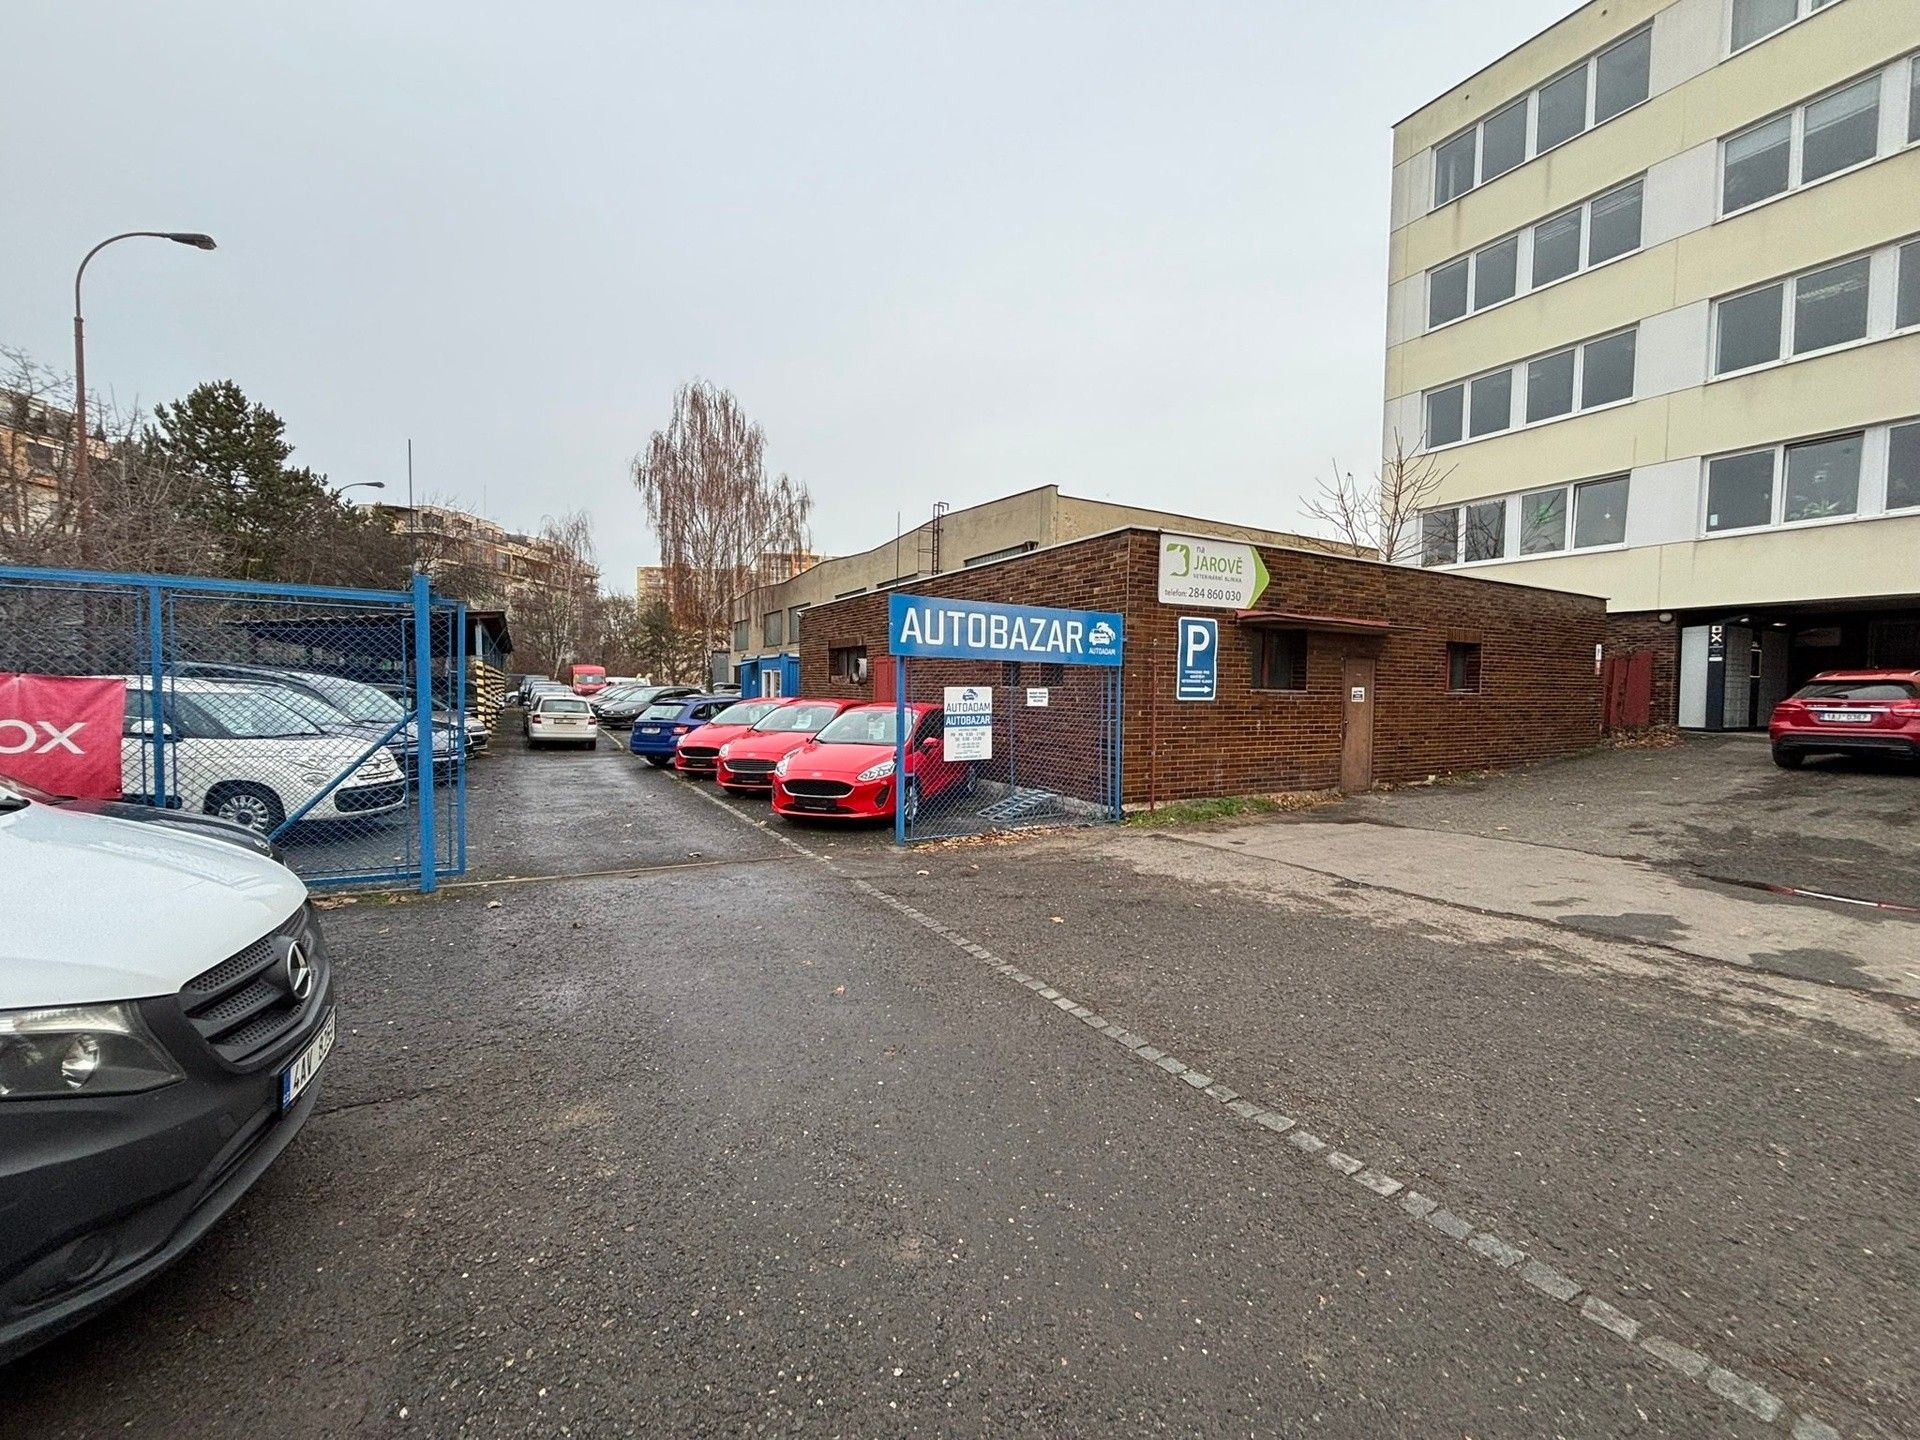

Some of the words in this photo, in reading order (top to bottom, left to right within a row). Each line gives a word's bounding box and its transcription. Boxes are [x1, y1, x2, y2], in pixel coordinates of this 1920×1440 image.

[1196, 546, 1205, 554] na
[1193, 555, 1243, 575] JAROVĚ
[1164, 588, 1188, 598] telefon:
[1188, 587, 1205, 599] 284
[1206, 588, 1224, 600] 860
[1224, 590, 1242, 602] 030
[899, 607, 1084, 654] AUTOBAZAR
[1186, 624, 1210, 667] P
[945, 702, 991, 713] AUTOADAM
[945, 715, 991, 726] AUTOBAZAR
